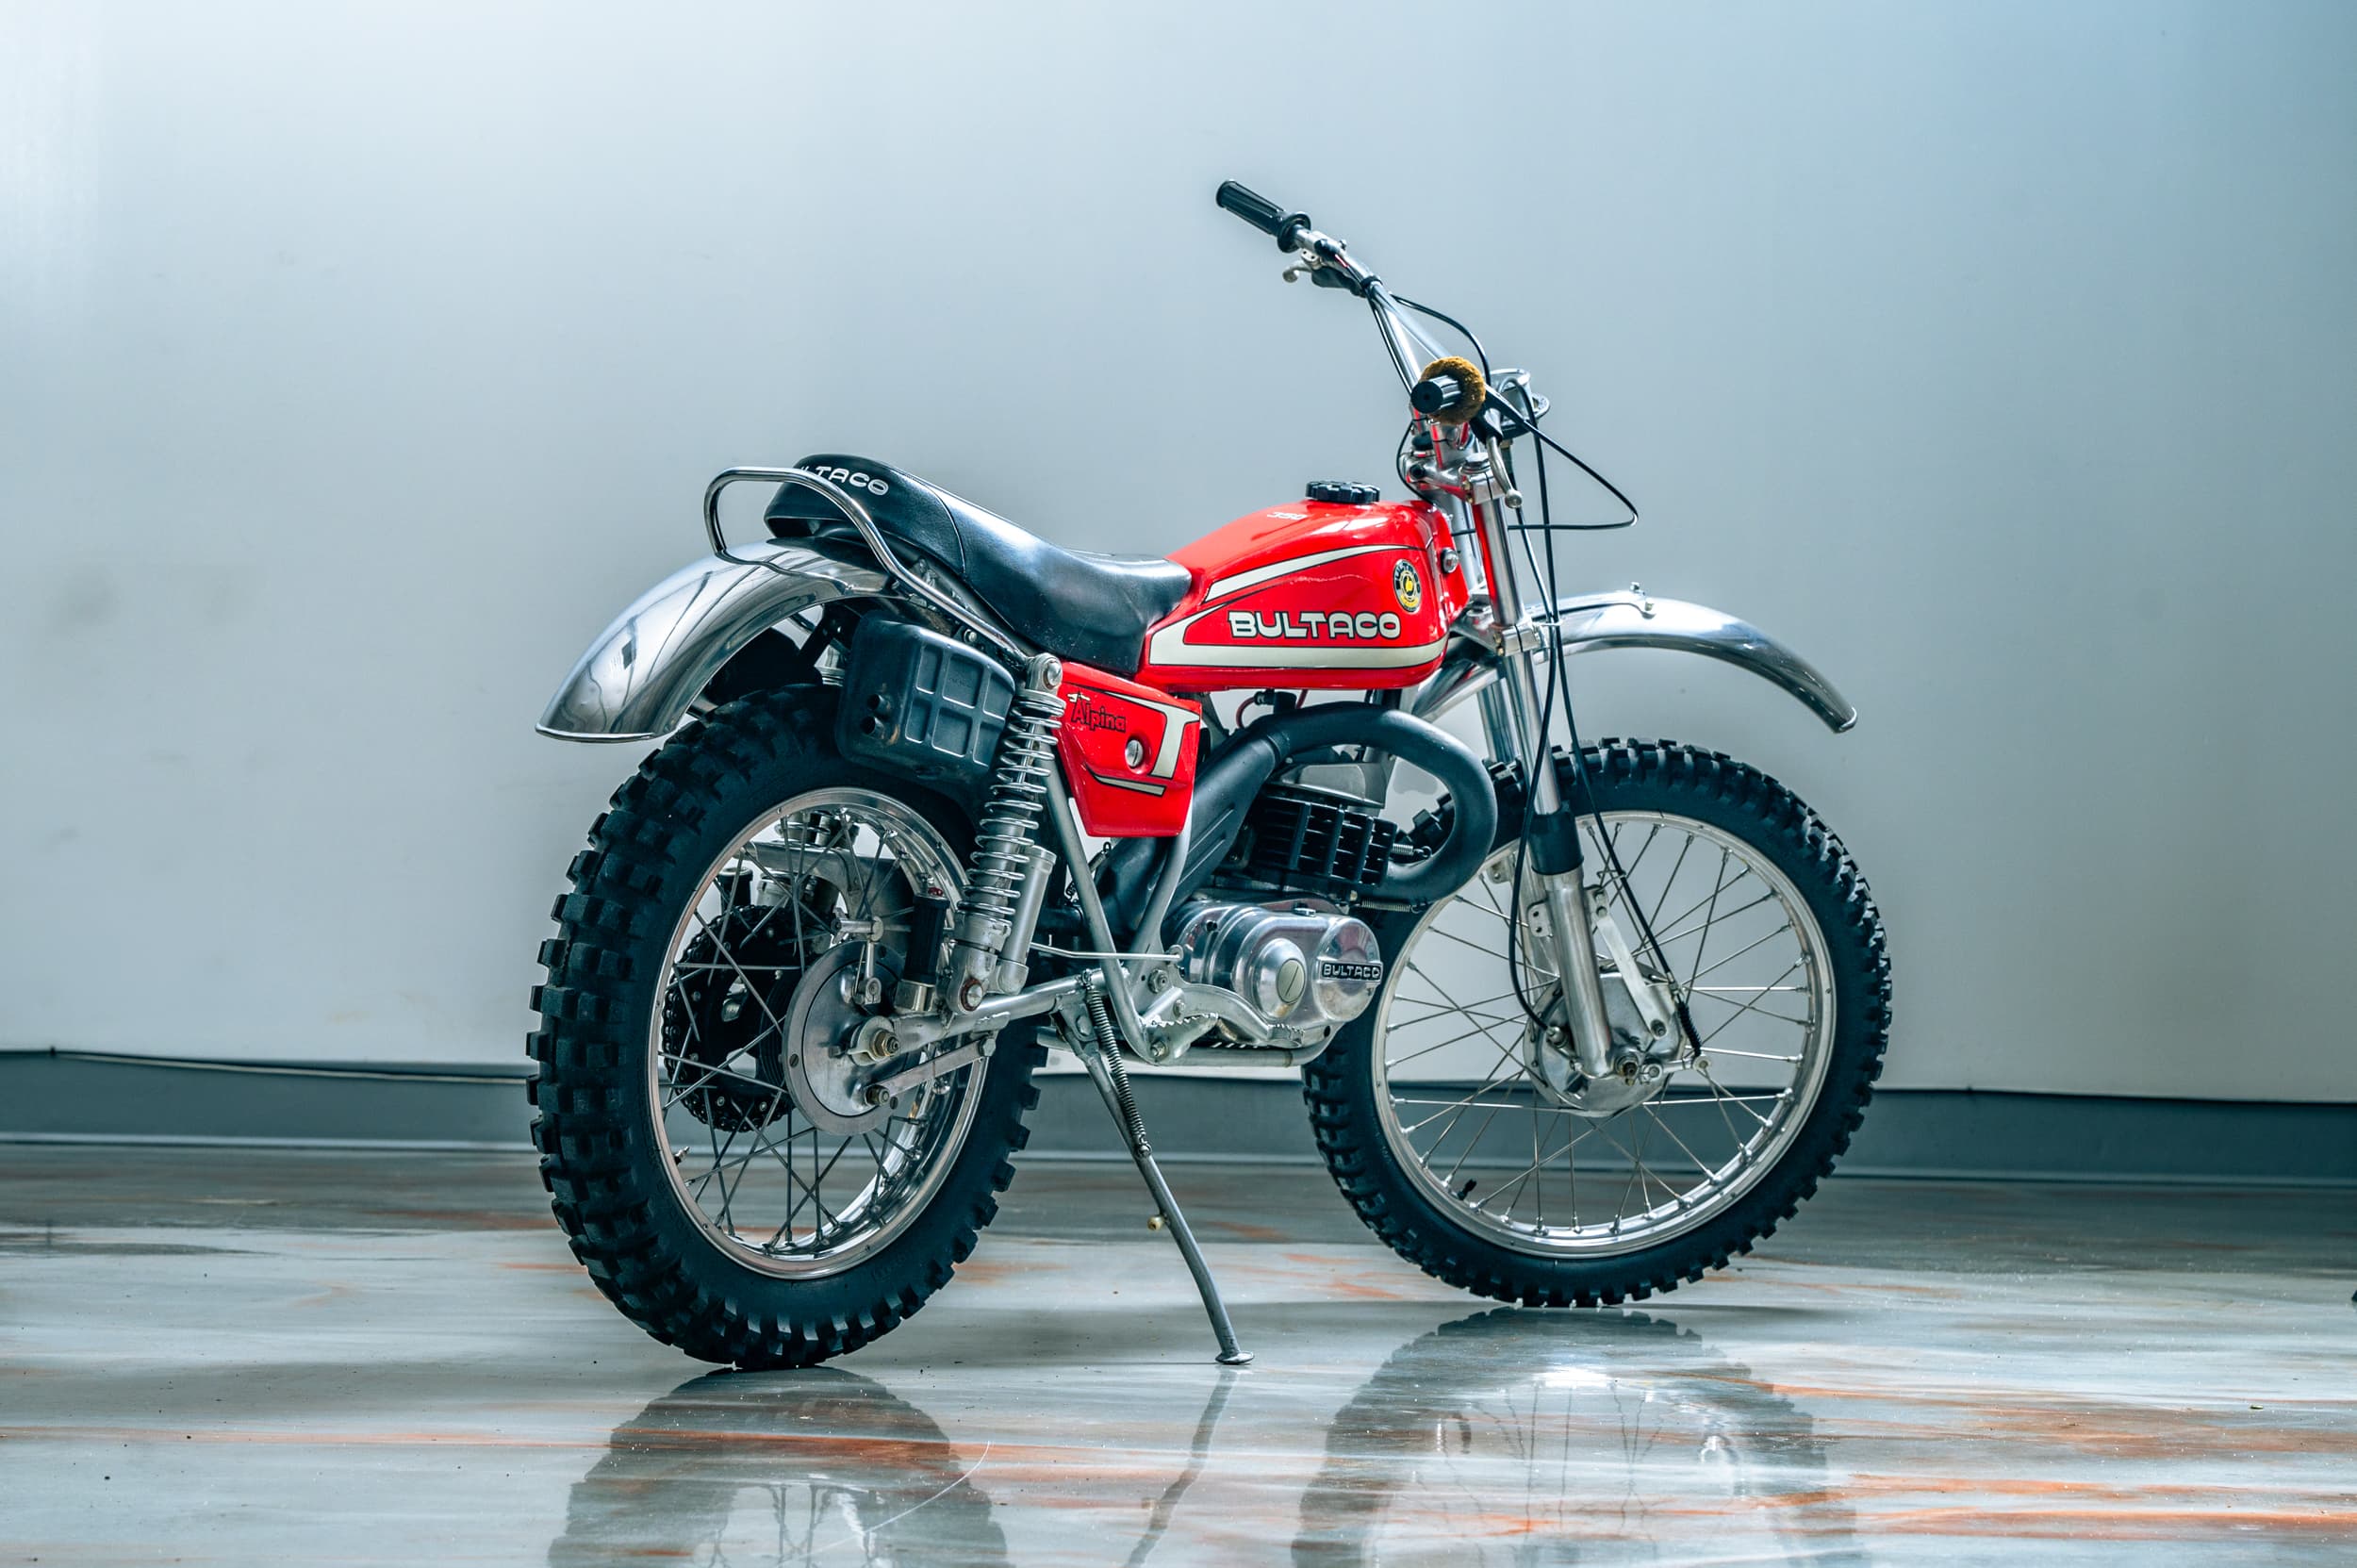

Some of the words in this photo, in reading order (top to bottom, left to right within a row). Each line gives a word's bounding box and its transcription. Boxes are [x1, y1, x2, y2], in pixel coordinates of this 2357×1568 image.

[800, 466, 889, 496] TACO
[1228, 611, 1401, 639] BULTACO
[1071, 689, 1127, 733] Alpina
[1324, 964, 1380, 978] BULTACO
